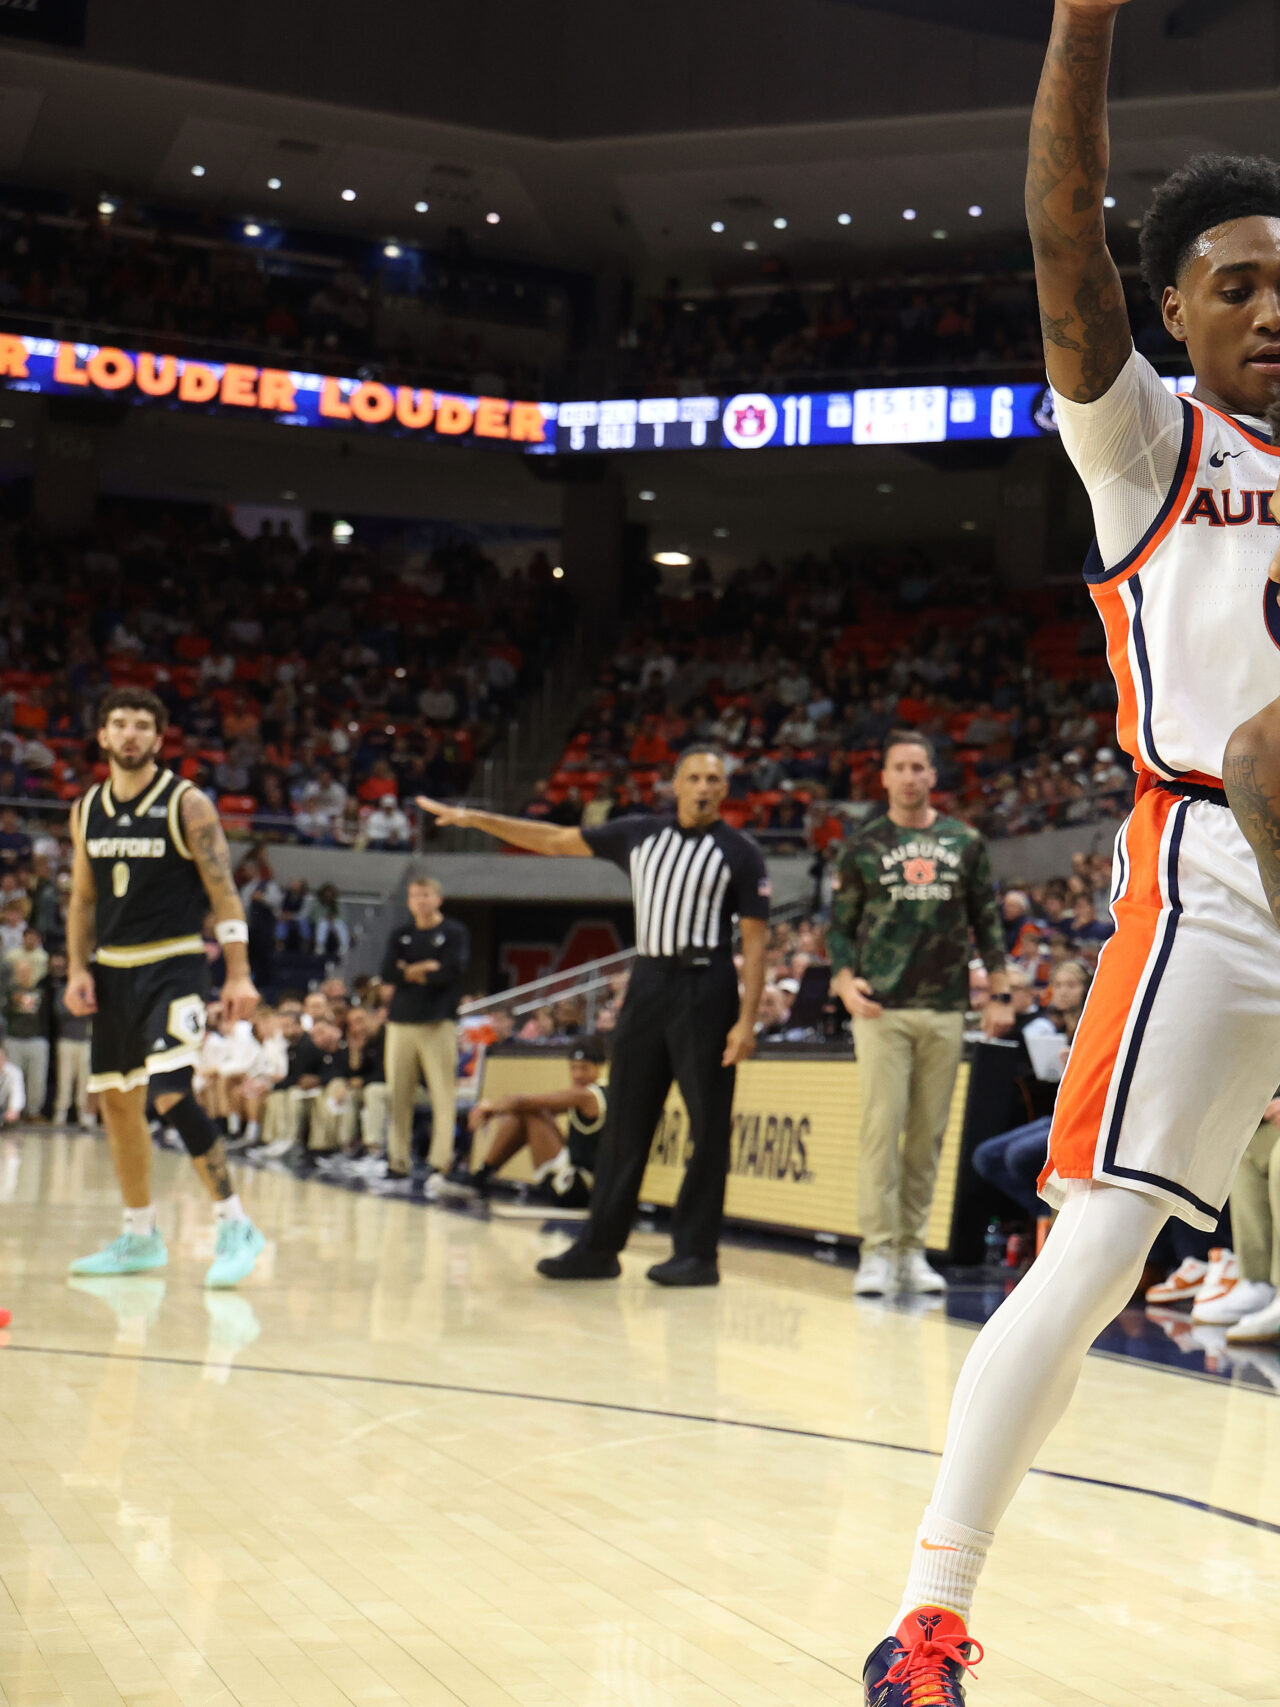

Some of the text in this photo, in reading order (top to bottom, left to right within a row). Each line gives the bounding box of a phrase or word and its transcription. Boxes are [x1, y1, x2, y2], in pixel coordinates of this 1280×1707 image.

[53, 340, 297, 412] LOUDER
[319, 376, 547, 443] LOUDER
[990, 386, 1014, 438] 6
[783, 395, 811, 446] 11
[882, 842, 961, 870] AUBURN
[888, 884, 952, 901] TIGERS
